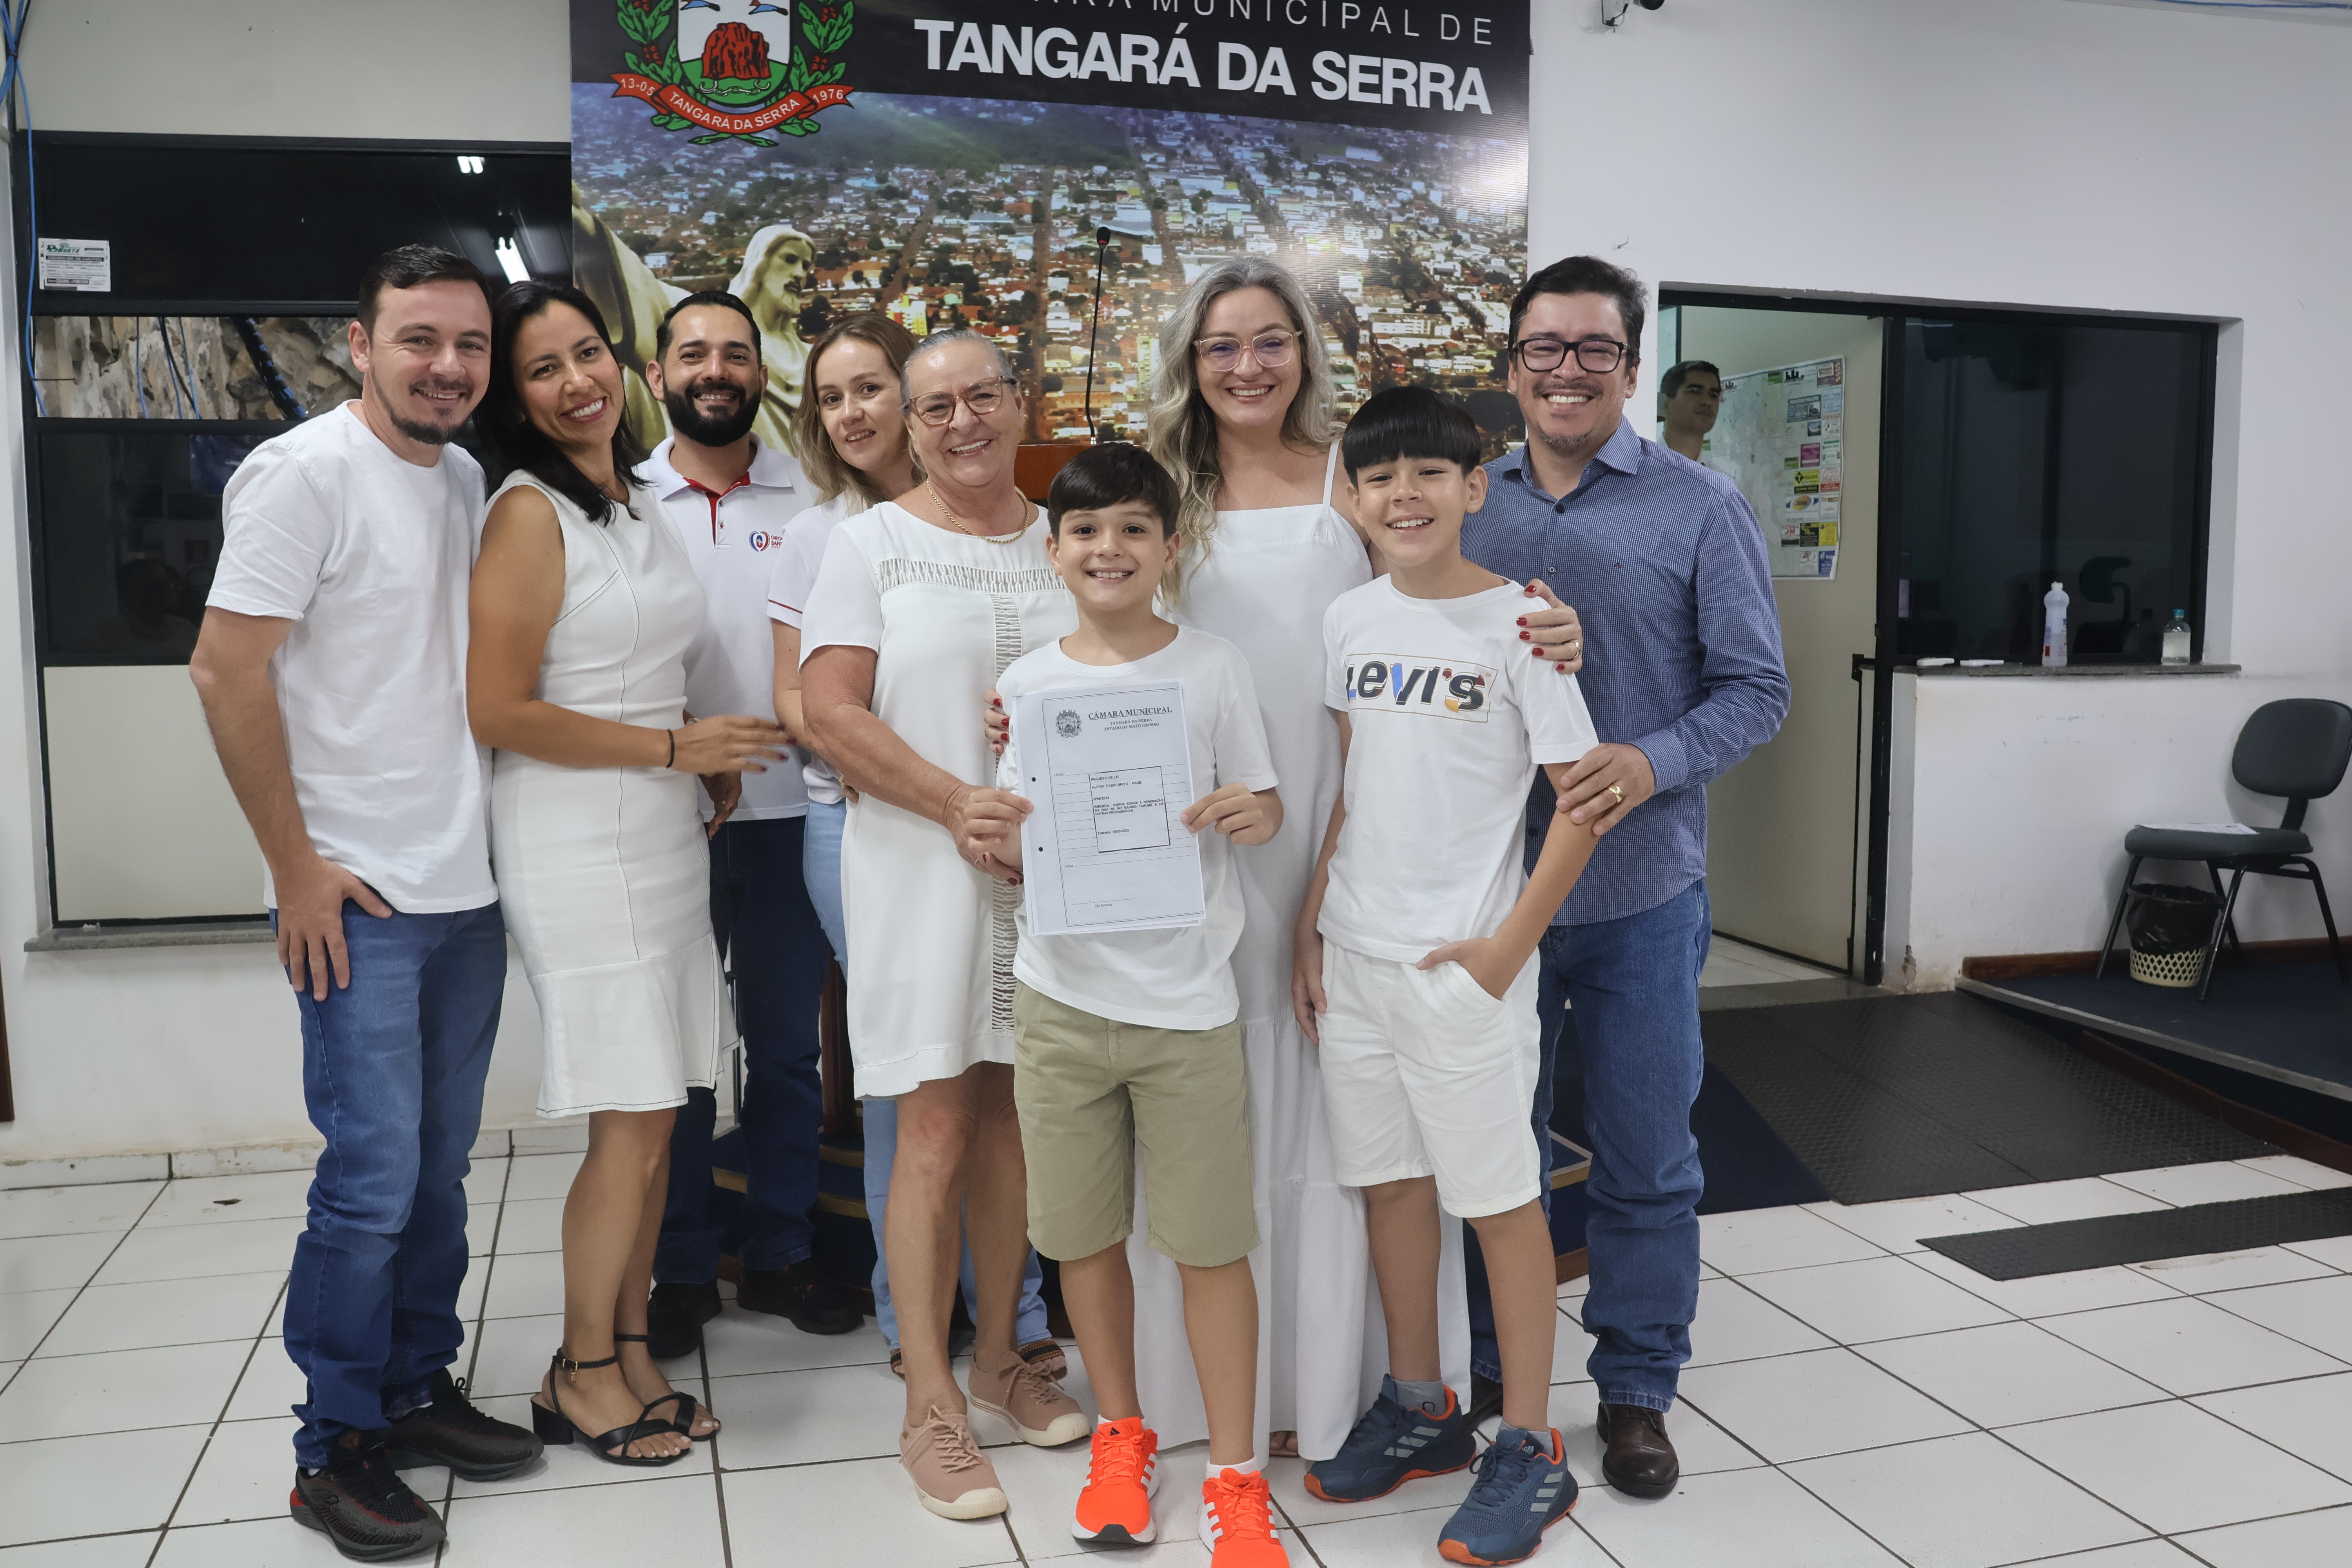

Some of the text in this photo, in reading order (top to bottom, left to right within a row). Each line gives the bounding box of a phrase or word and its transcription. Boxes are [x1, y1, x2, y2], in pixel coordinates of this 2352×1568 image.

[1441, 13, 1492, 45] DE
[914, 18, 1493, 115] TANGARÁ DA SERRA
[621, 78, 655, 97] 13-05
[812, 89, 844, 103] 1976
[670, 92, 800, 130] TANGARÁ DA SERRA
[1088, 706, 1172, 720] CÂMARA MUNICIPAL
